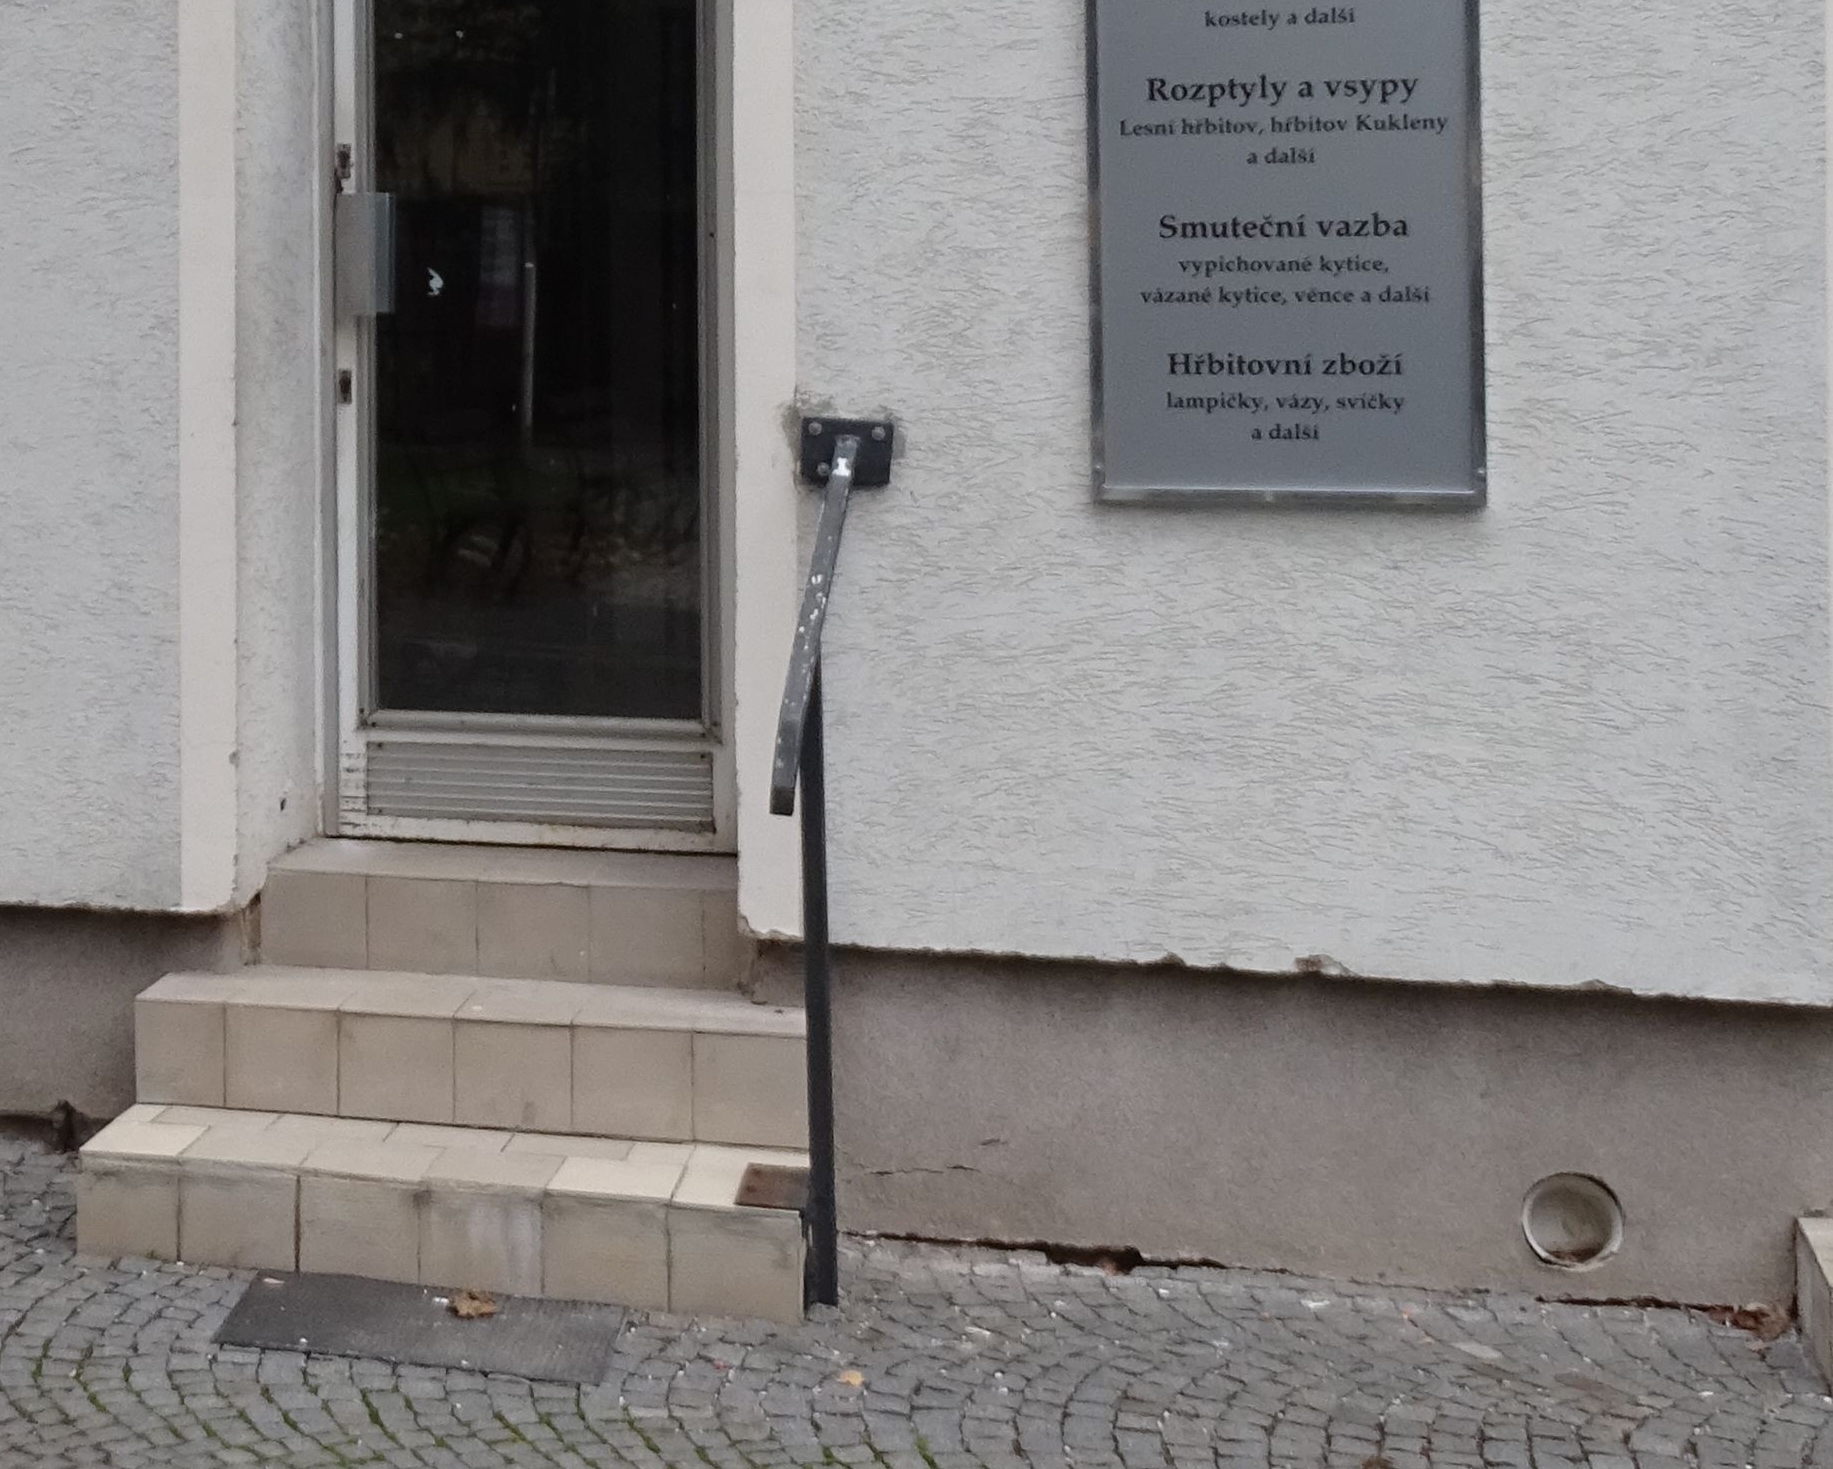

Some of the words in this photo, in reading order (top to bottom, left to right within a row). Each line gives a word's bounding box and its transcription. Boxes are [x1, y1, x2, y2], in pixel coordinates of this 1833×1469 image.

[1205, 9, 1279, 30] kostely
[1286, 11, 1297, 26] a
[1304, 10, 1355, 25] další
[1145, 75, 1287, 107] Rozptyly
[1298, 79, 1314, 97] a
[1323, 77, 1419, 103] vsypy
[1119, 118, 1174, 137] Lesní
[1181, 118, 1264, 136] hřbitov,
[1270, 117, 1348, 133] hřbitov
[1355, 114, 1449, 134] Kukleny
[1246, 151, 1258, 165] a
[1264, 148, 1315, 165] další
[1158, 214, 1306, 240] Smuteční
[1315, 212, 1410, 238] vazba
[1178, 256, 1313, 278] vypichované
[1319, 256, 1389, 275] kytice,
[1140, 289, 1212, 304] vázané
[1217, 287, 1286, 309] kytice,
[1361, 289, 1372, 303] a
[1378, 287, 1430, 304] další
[1167, 353, 1312, 377] Hřbitovní
[1322, 353, 1404, 377] zboží
[1166, 392, 1267, 414] lampičky,
[1275, 394, 1330, 414] vázy,
[1251, 427, 1262, 441] a
[1268, 423, 1320, 441] další
